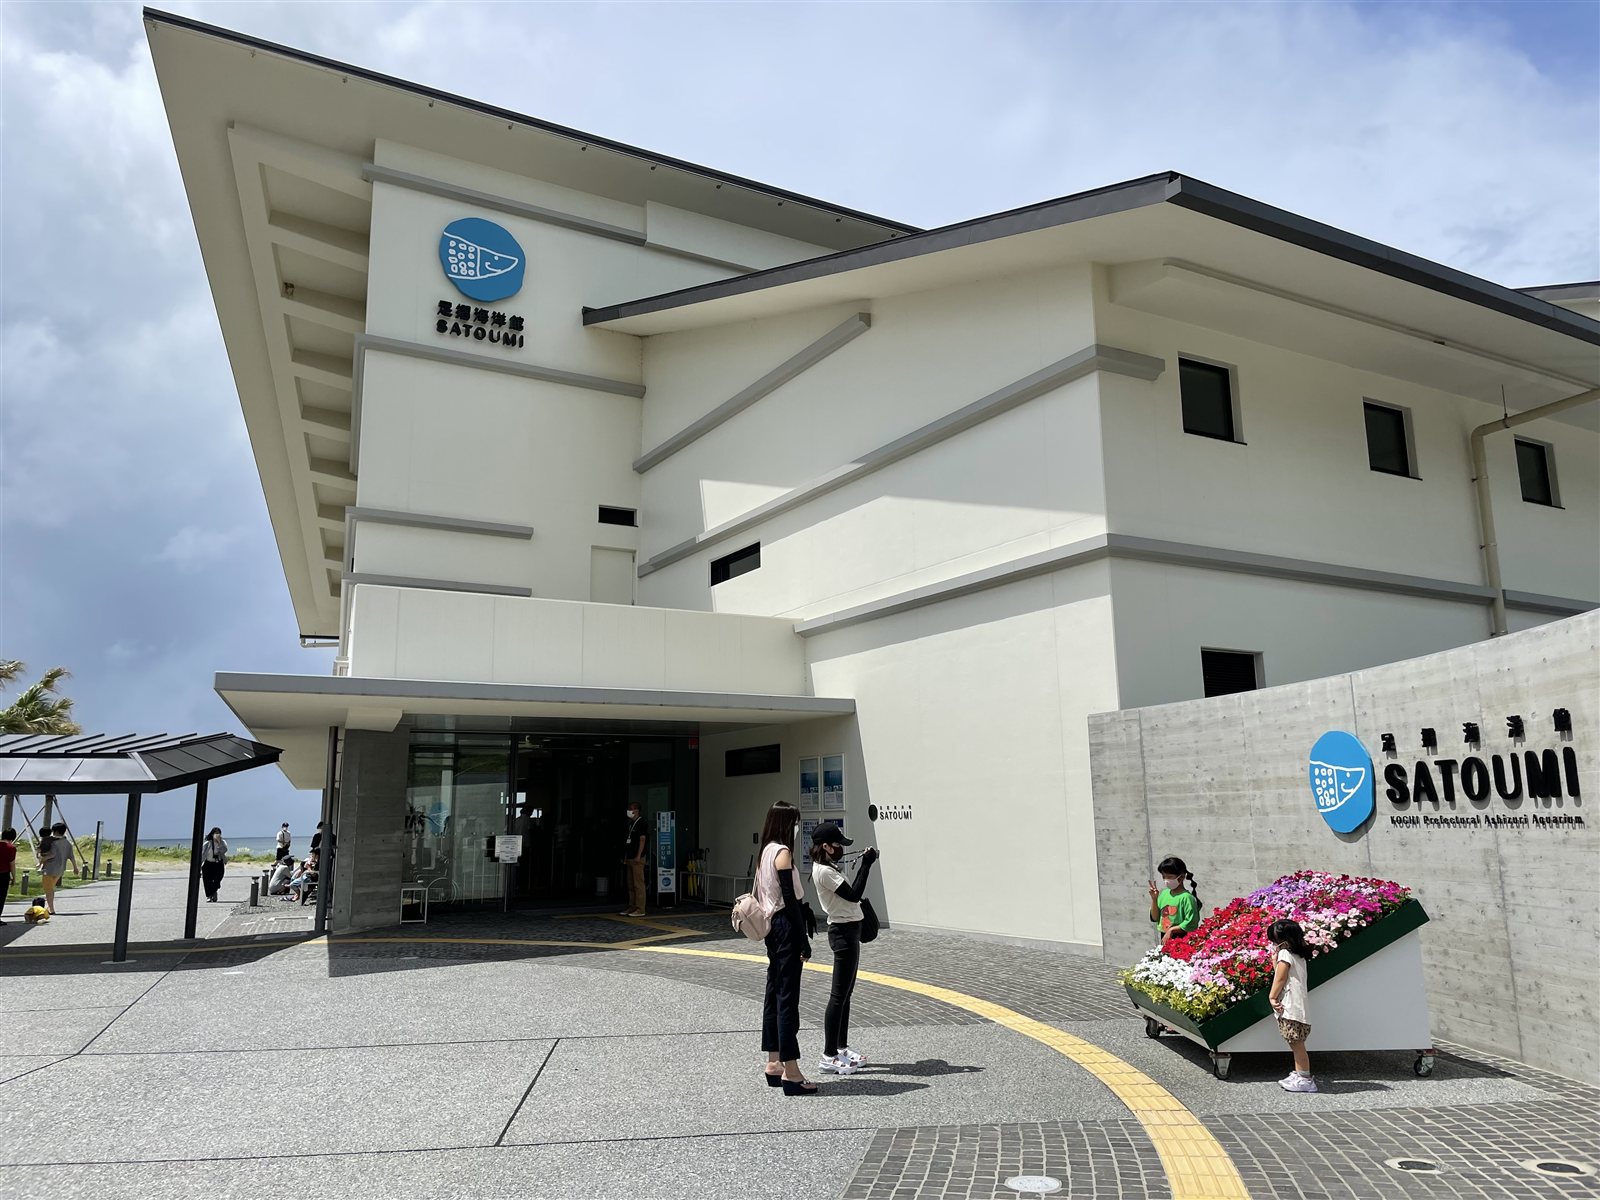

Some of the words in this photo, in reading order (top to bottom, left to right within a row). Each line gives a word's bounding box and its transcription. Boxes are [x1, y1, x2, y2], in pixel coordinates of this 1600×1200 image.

[436, 319, 524, 348] SATOUMI
[1384, 747, 1581, 804] SATOUMI
[879, 811, 912, 820] SATOUMI
[1423, 814, 1481, 825] Prefectural
[1484, 814, 1529, 824] Ashizuri
[1532, 813, 1583, 825] Aquarium
